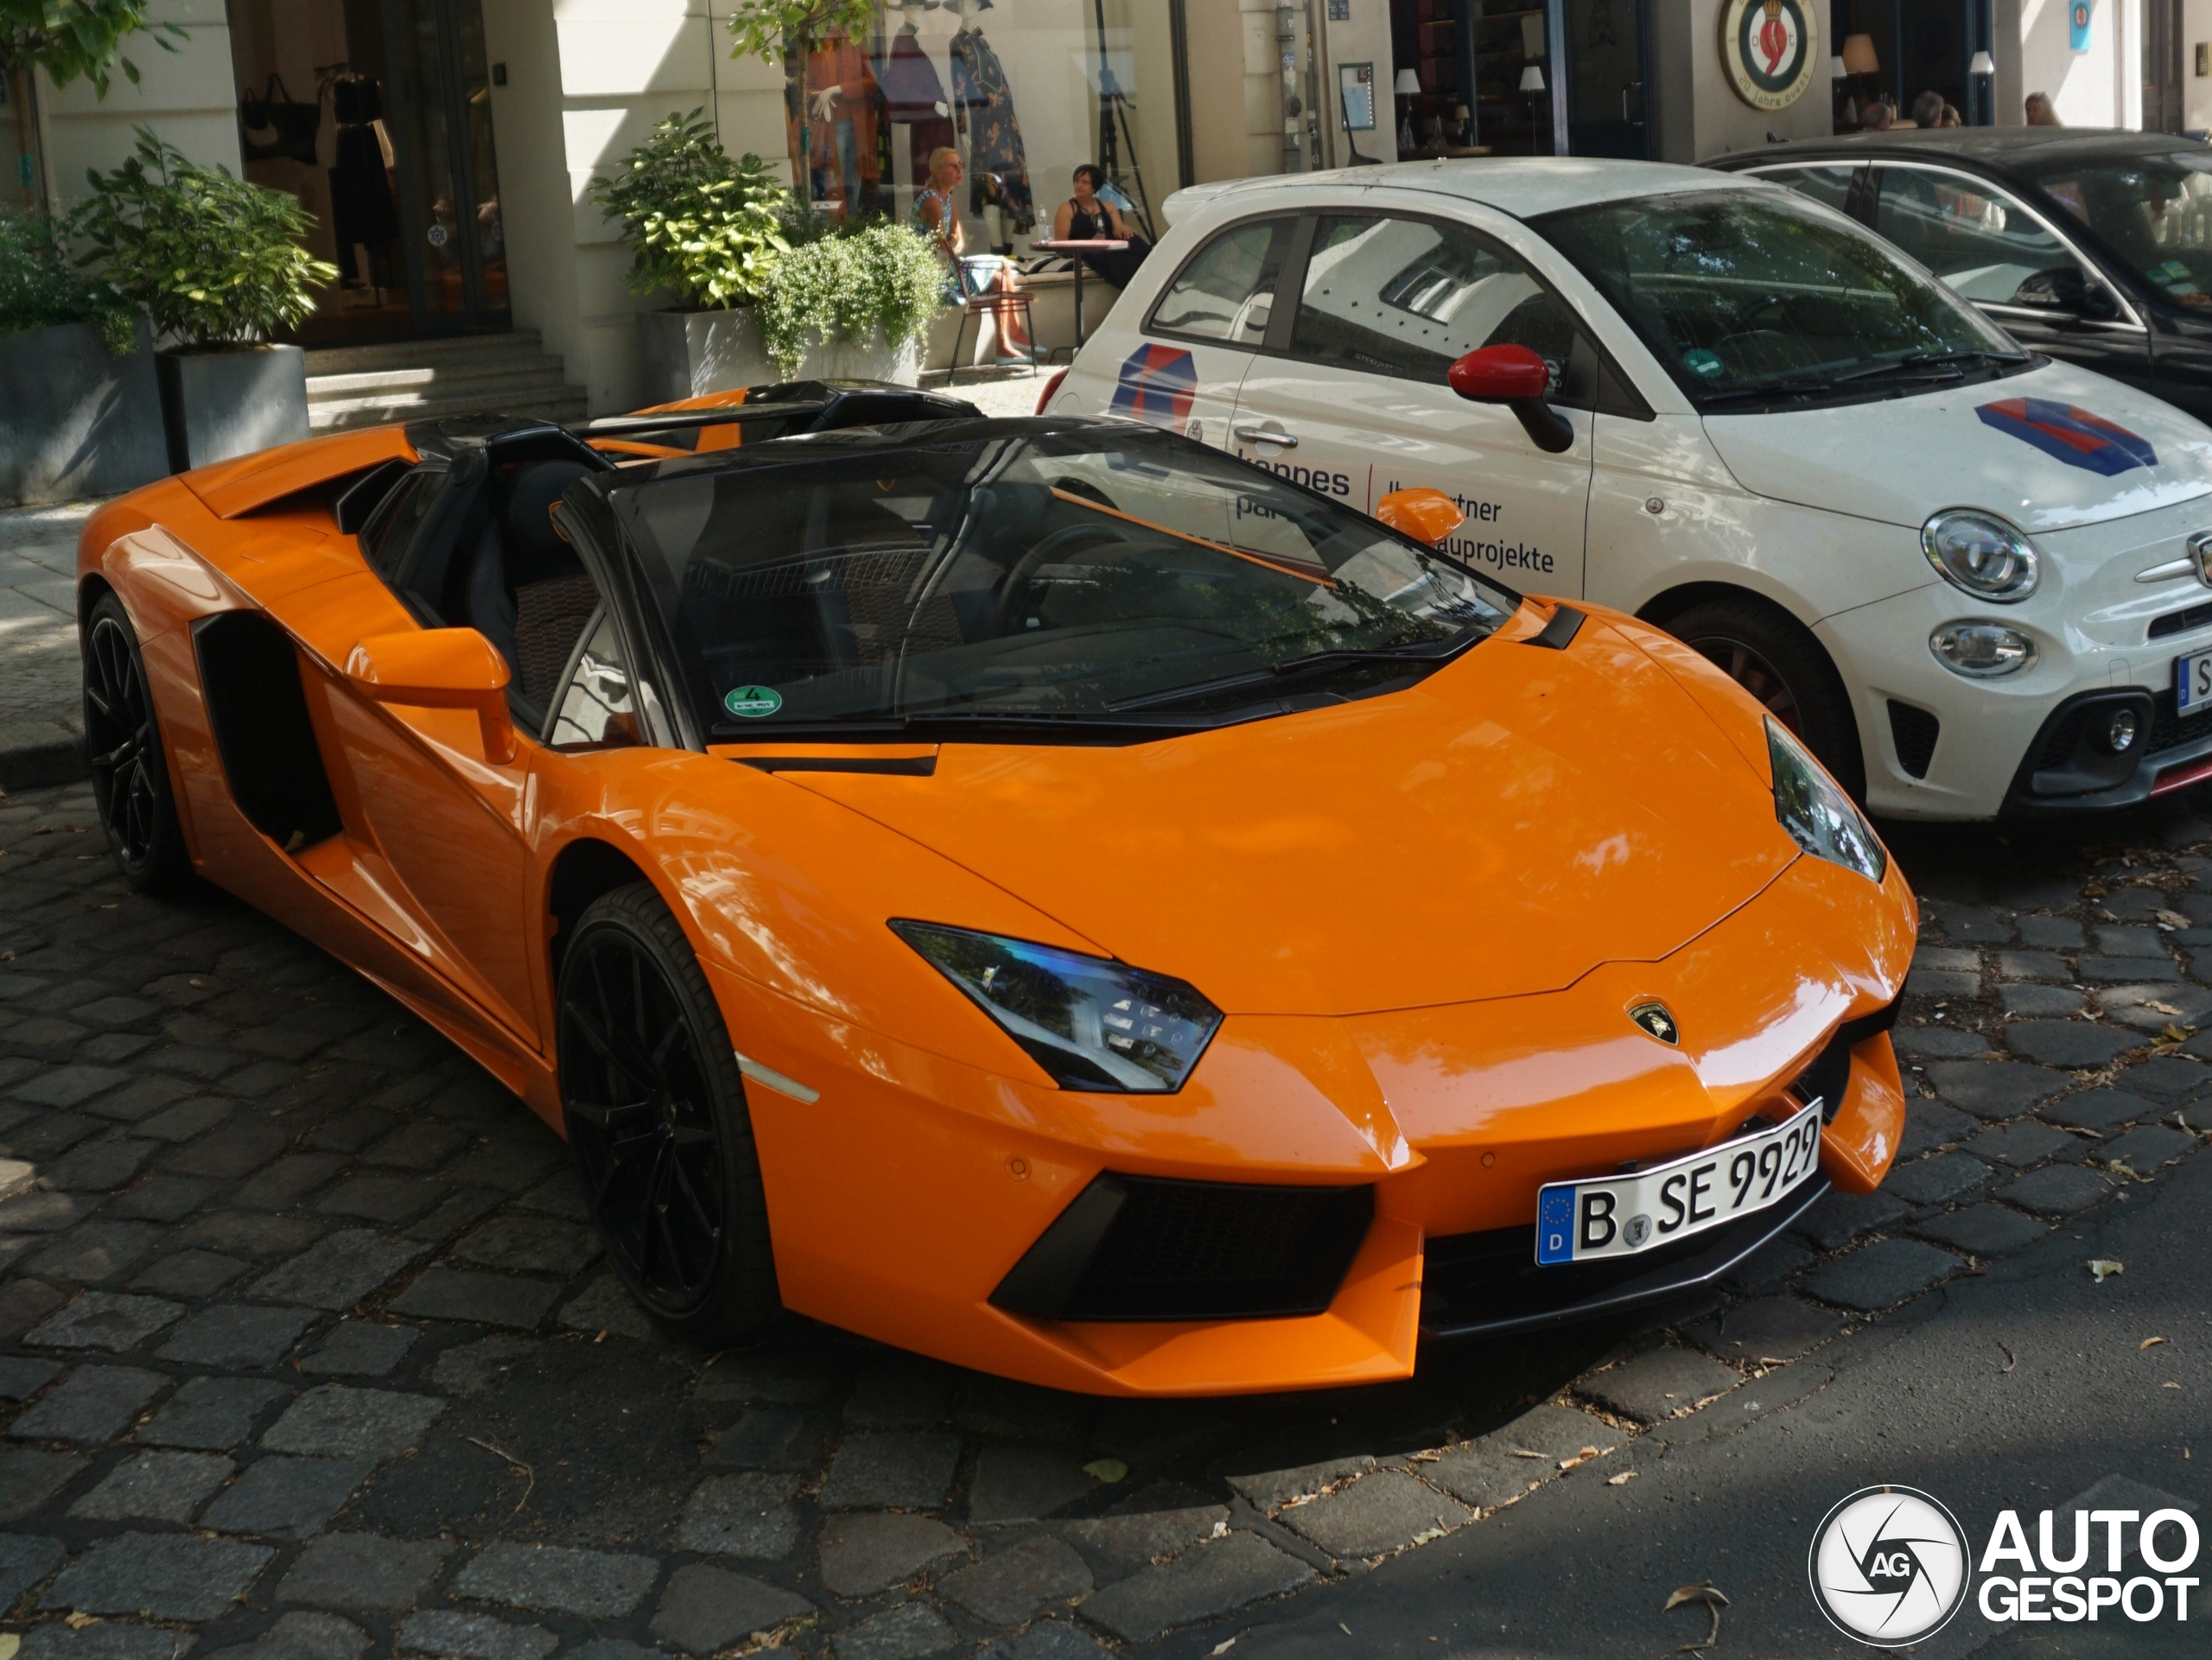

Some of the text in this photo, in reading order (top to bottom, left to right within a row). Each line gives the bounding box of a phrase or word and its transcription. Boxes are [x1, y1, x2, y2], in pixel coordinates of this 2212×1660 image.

[1738, 72, 1809, 106] 20 jahre ovest
[1437, 537, 1554, 574] auprojekte
[745, 688, 761, 701] 4
[2181, 689, 2187, 700] D
[1549, 1114, 1818, 1250] D B SE 9929
